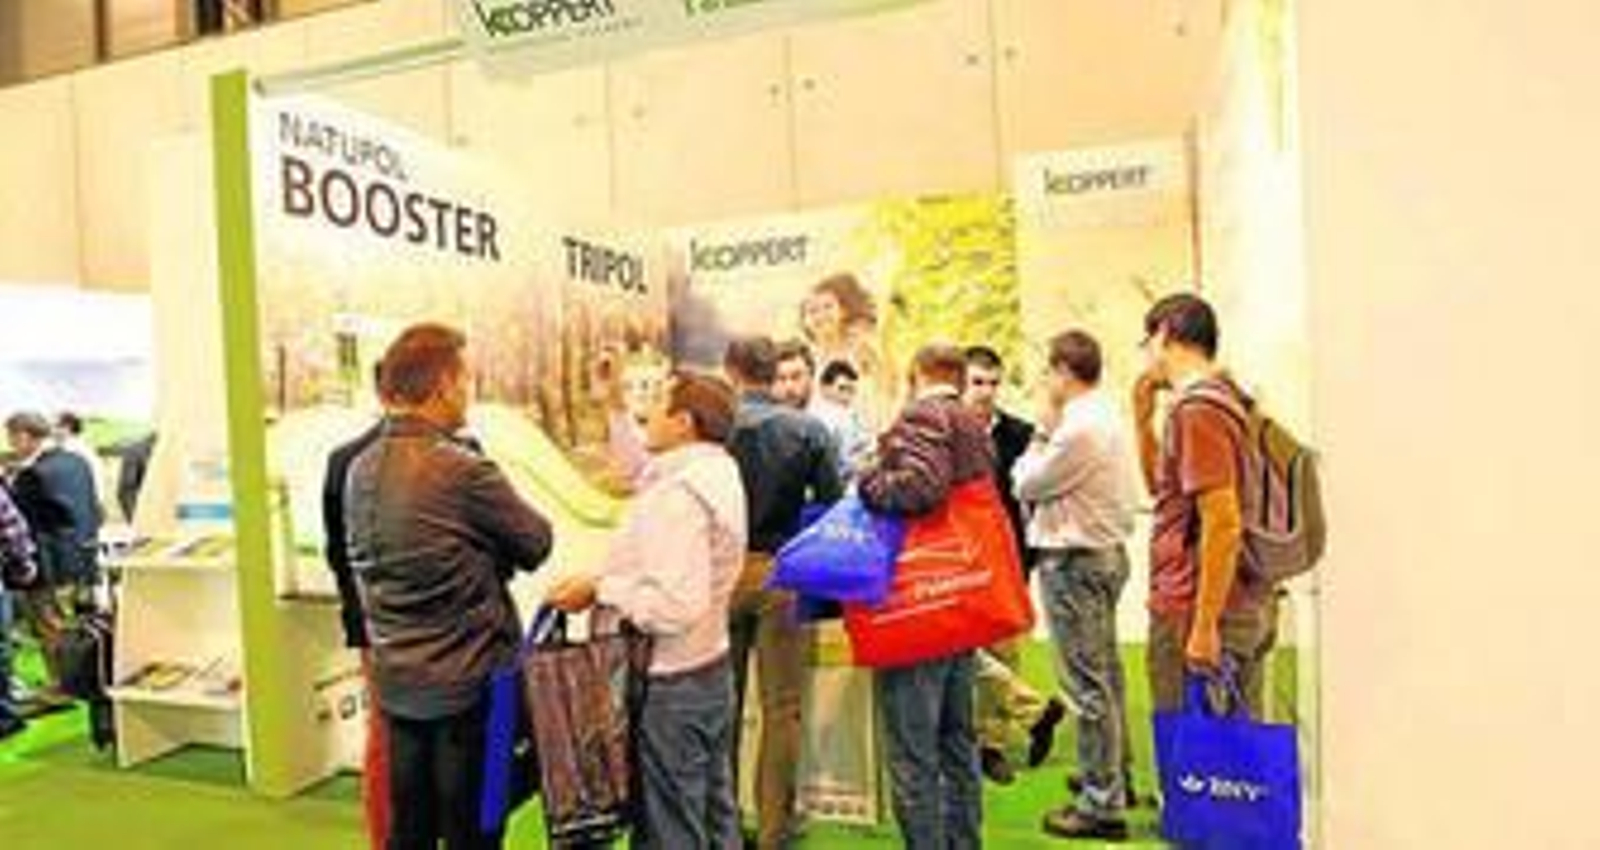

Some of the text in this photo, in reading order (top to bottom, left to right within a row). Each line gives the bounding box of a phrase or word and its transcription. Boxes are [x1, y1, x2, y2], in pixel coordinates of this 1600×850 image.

[278, 111, 408, 182] NATUPOL
[281, 153, 501, 262] BOOSTER
[1043, 164, 1150, 195] KOPPERT
[561, 236, 649, 295] TRIPOL
[689, 235, 807, 272] KOPPERT
